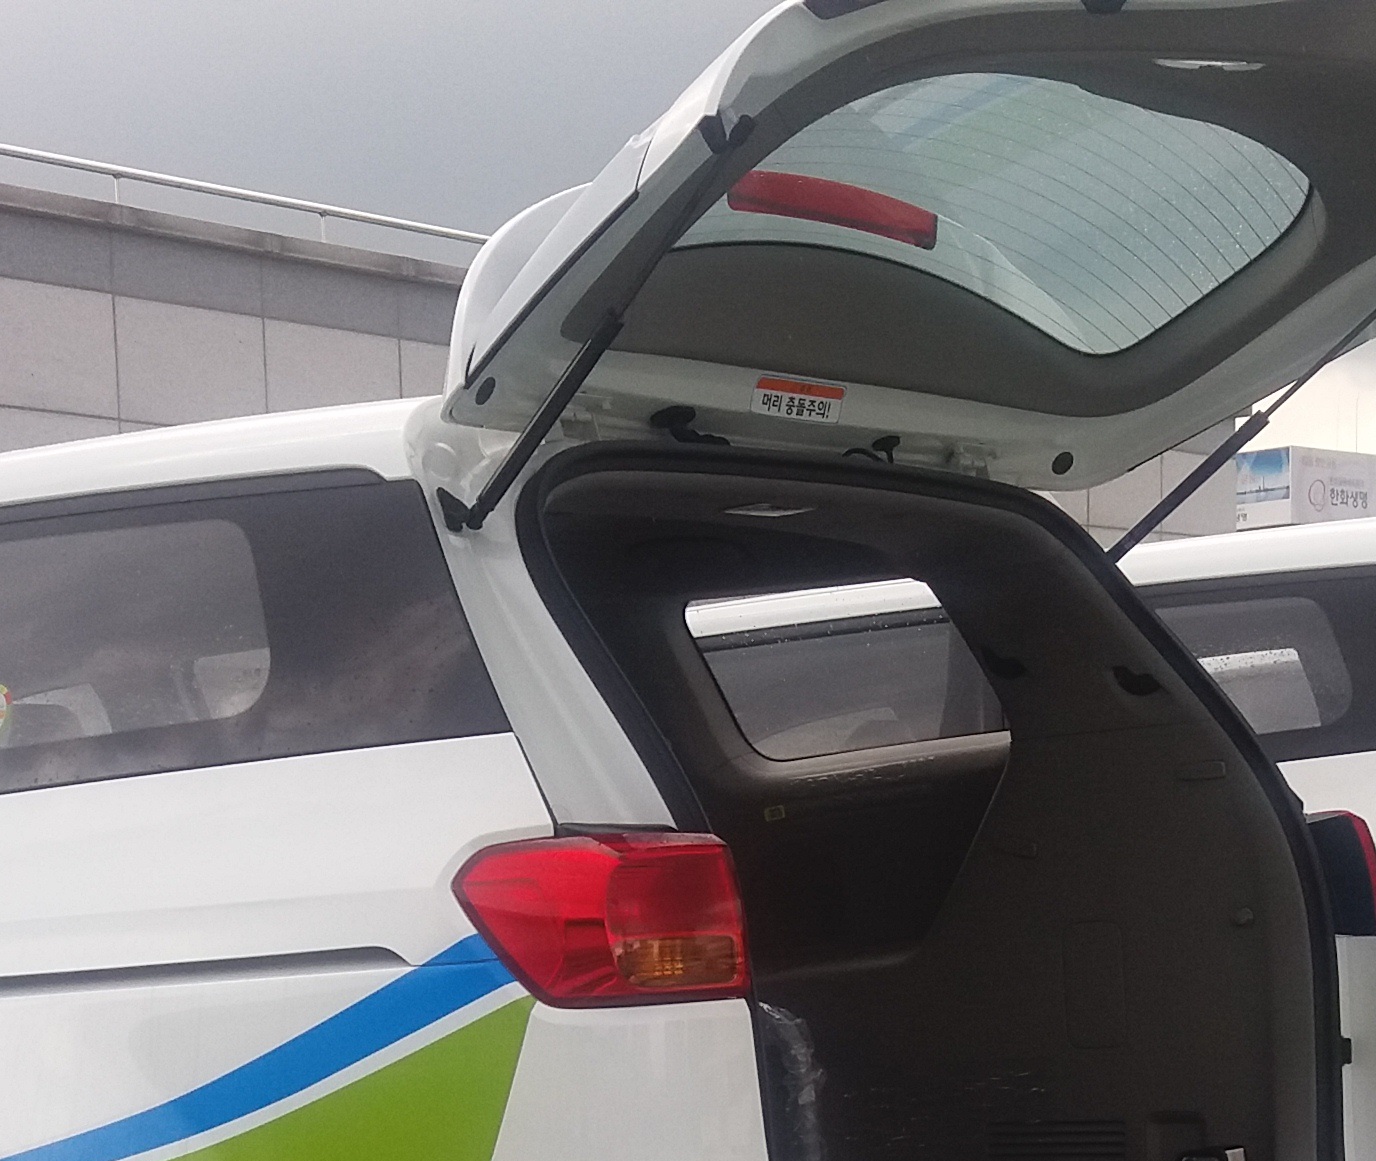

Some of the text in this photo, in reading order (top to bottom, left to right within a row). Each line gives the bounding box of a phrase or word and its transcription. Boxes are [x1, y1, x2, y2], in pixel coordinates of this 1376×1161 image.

[761, 393, 832, 419] 머리 충돌주의!
[1329, 487, 1368, 510] 한화생명
